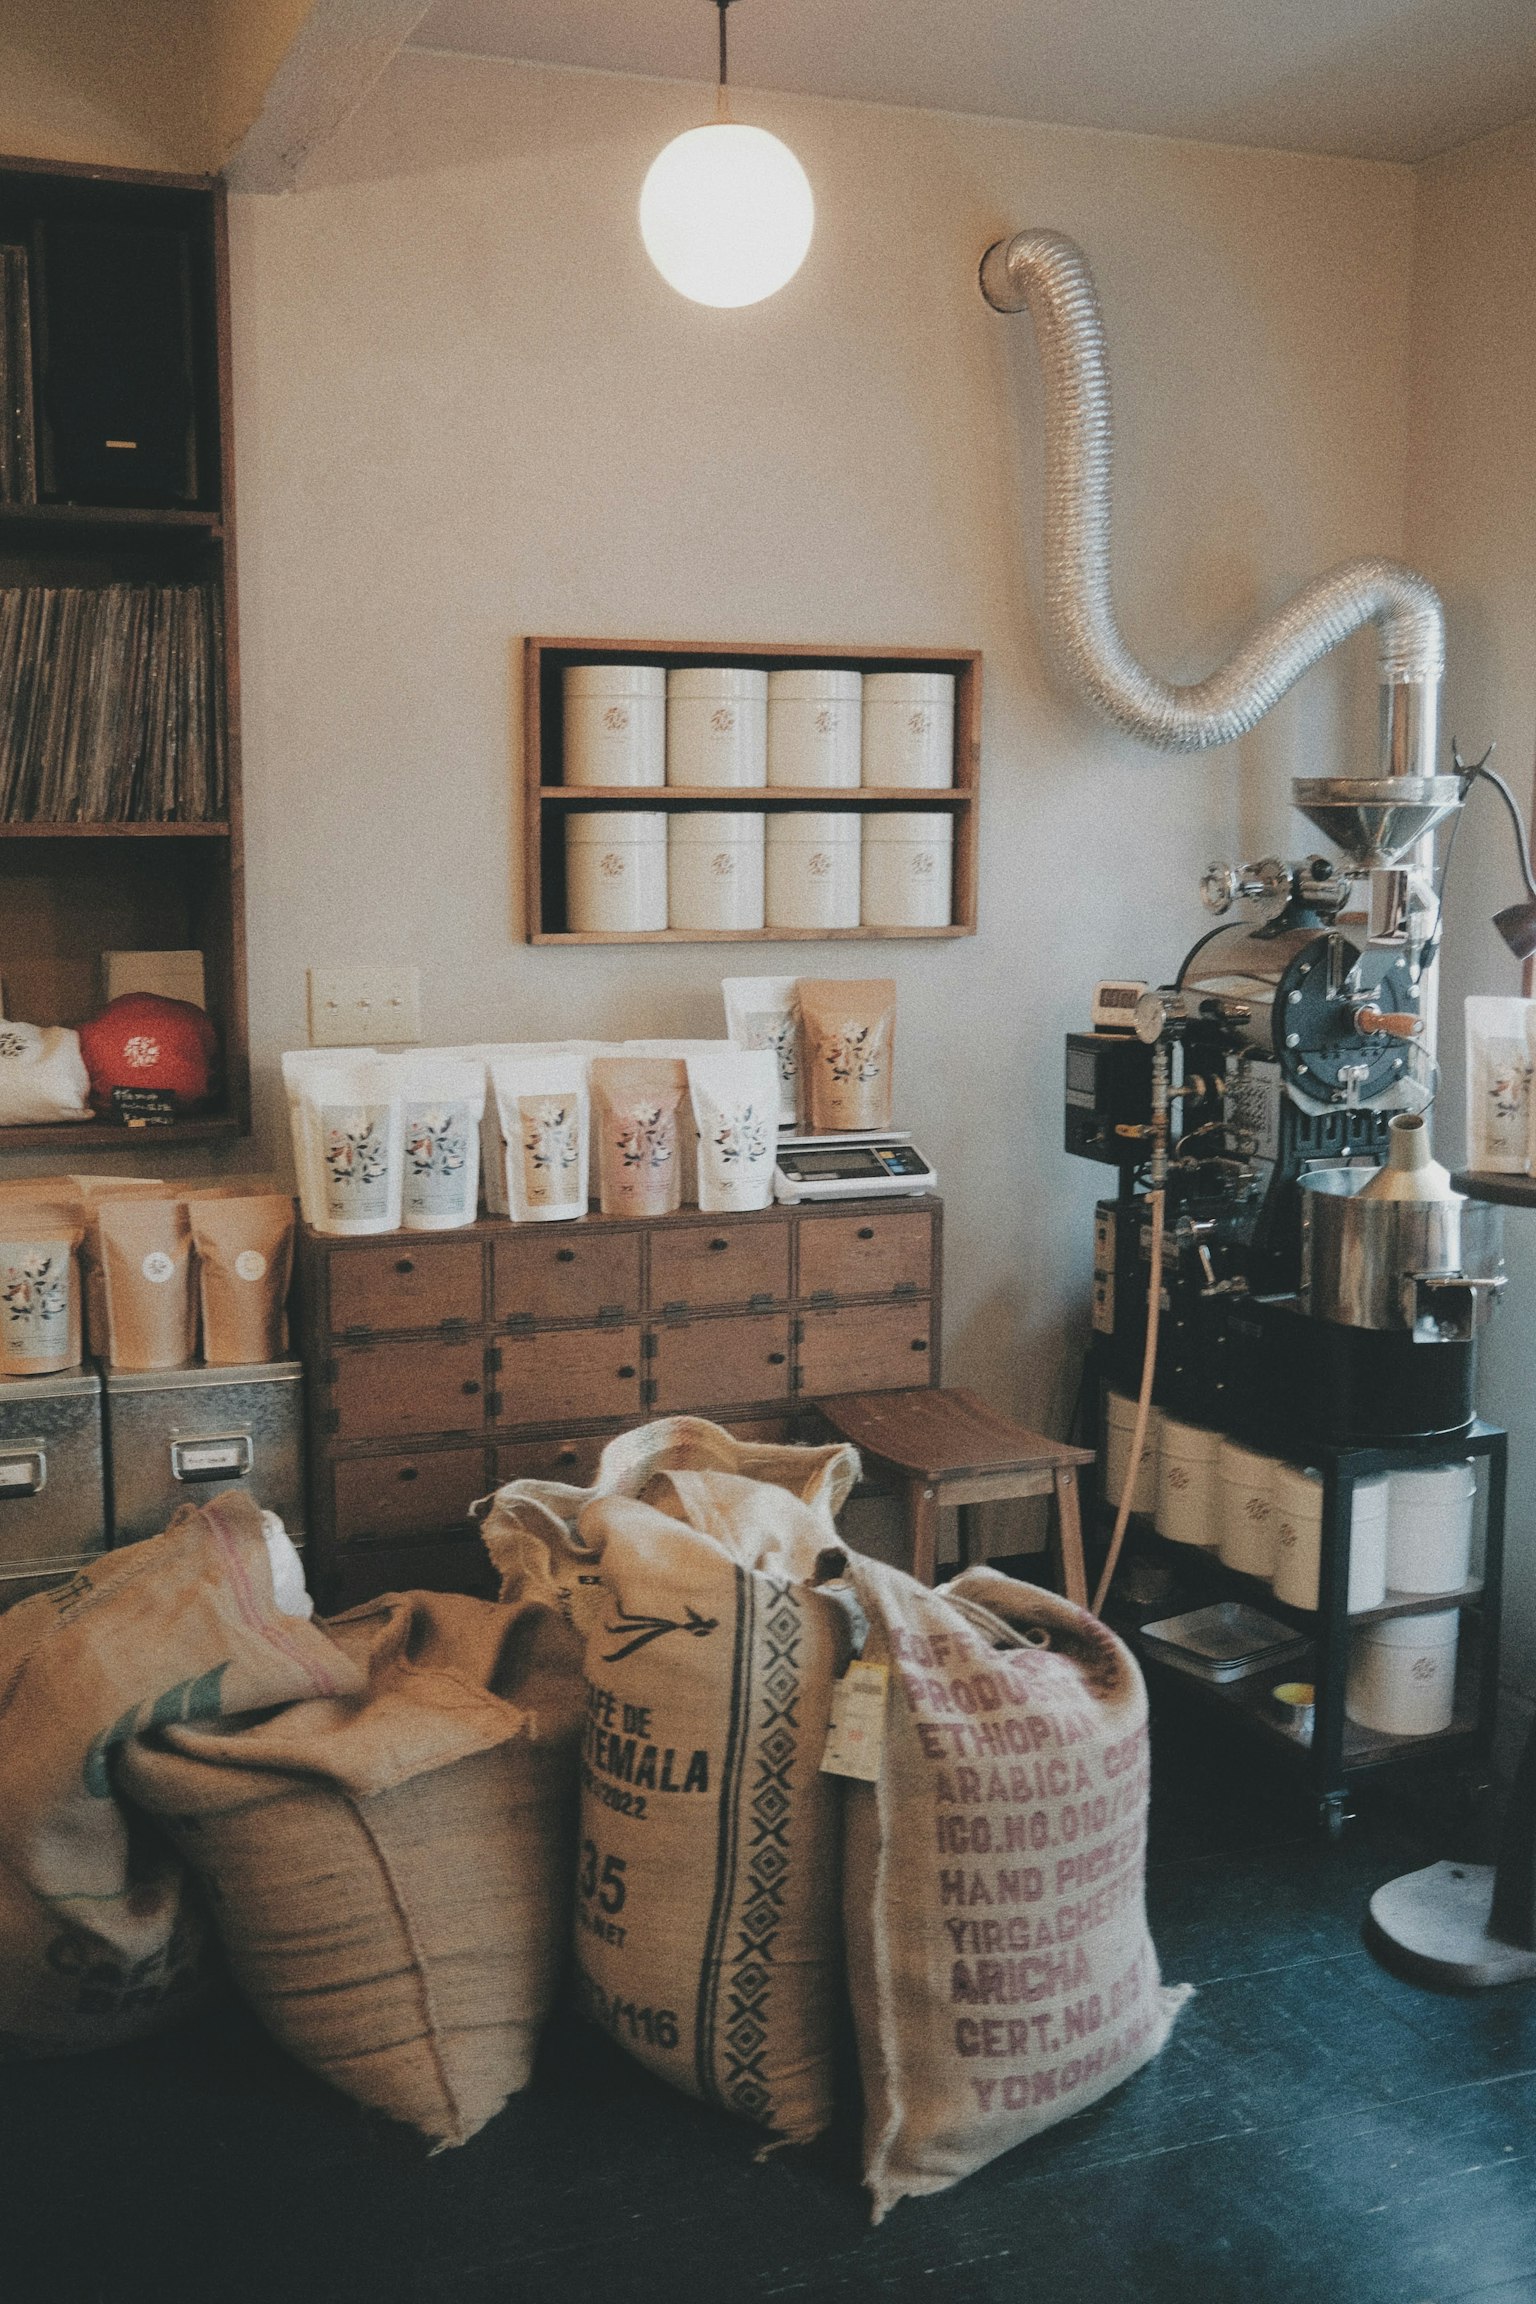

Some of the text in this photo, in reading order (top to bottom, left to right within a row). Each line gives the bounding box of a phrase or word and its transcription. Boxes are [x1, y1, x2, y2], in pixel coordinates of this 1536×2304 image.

[623, 1704, 652, 1739] DE
[936, 1758, 1093, 1804] ARABICA
[938, 1865, 1043, 1906] HAND
[950, 1945, 1091, 2006] ARICHA
